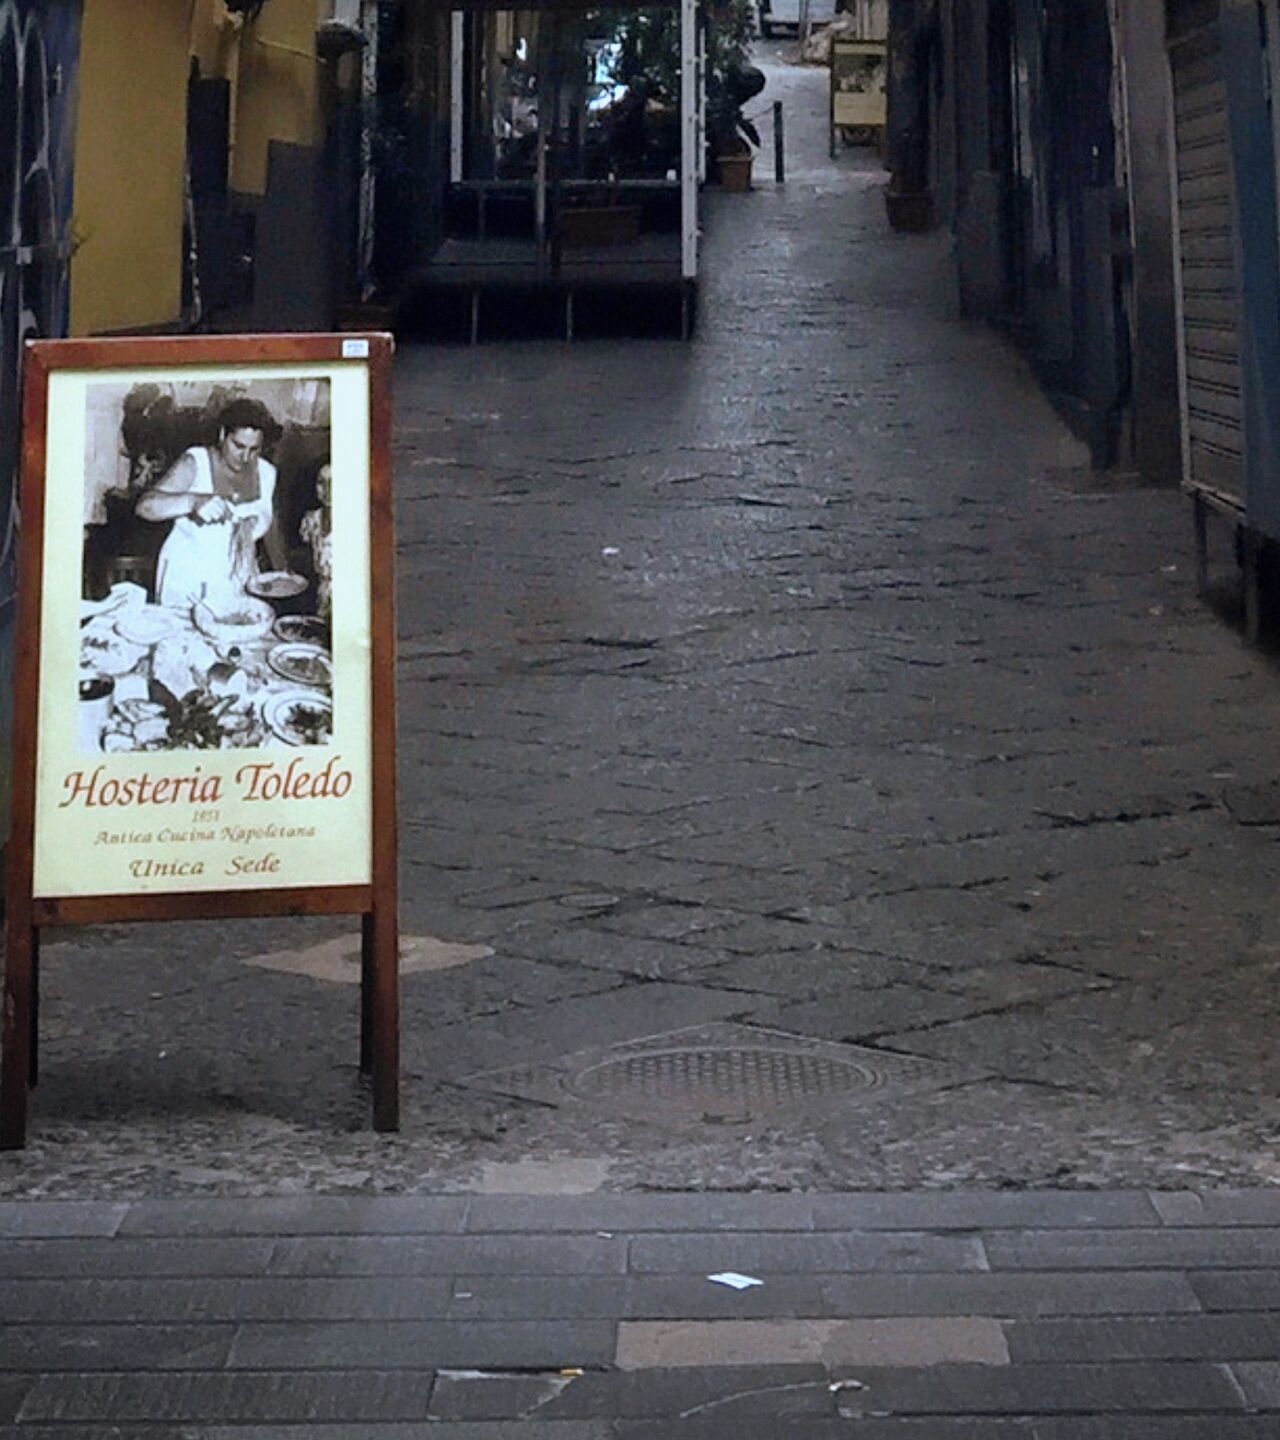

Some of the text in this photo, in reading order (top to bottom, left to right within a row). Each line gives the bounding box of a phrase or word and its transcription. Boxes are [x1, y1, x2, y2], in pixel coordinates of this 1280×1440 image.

[58, 755, 353, 809] Hosteria Toledo
[94, 823, 316, 846] Antica Cucina Napoletana
[129, 852, 281, 879] Unica Sede
